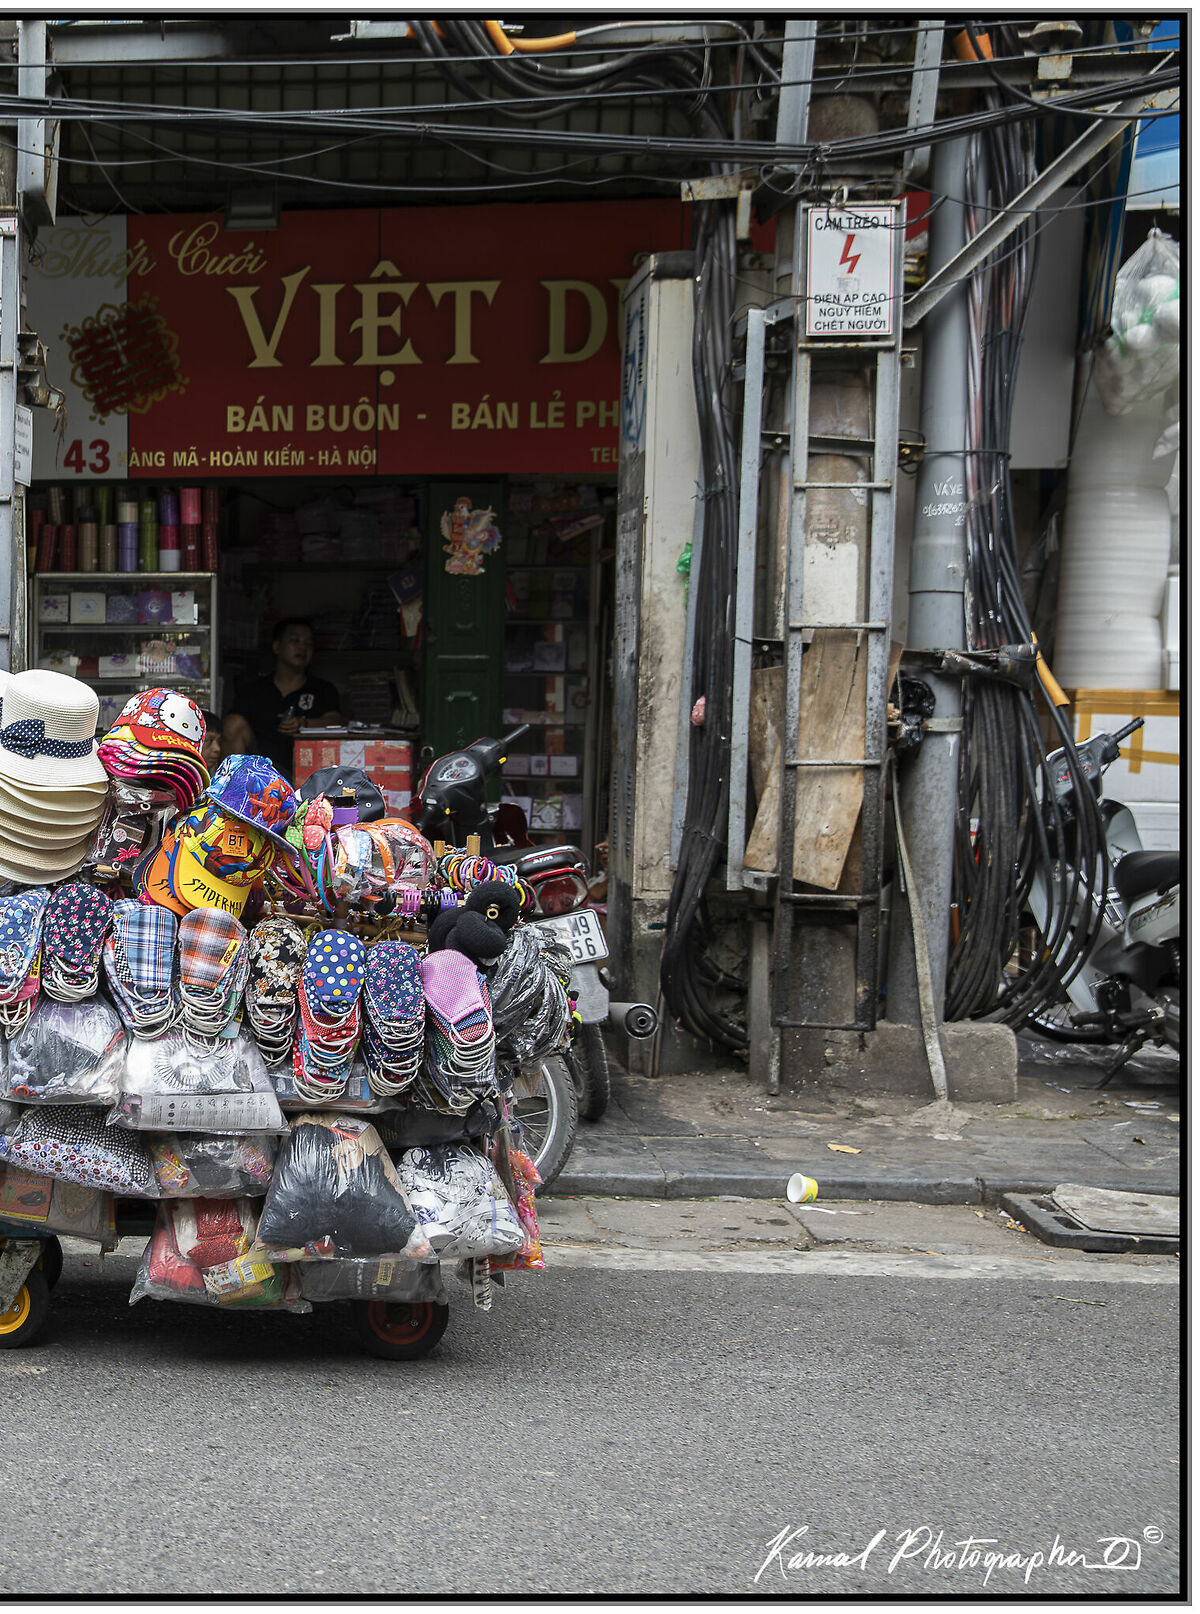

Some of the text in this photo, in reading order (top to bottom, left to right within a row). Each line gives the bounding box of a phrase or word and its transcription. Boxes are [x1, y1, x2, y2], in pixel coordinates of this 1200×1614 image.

[168, 220, 267, 276] Cưới
[819, 307, 851, 317] NGUY
[862, 293, 887, 303] CAO
[225, 260, 502, 386] VIỆT
[227, 395, 294, 432] BÁN
[306, 397, 400, 431] BUÔN
[451, 394, 518, 429] BÁN
[529, 390, 565, 429] LẺ
[64, 439, 110, 473] 43
[263, 443, 305, 466] KIẾM
[318, 445, 341, 466] HÀ
[347, 445, 377, 470] NỘI
[228, 834, 245, 847] BT
